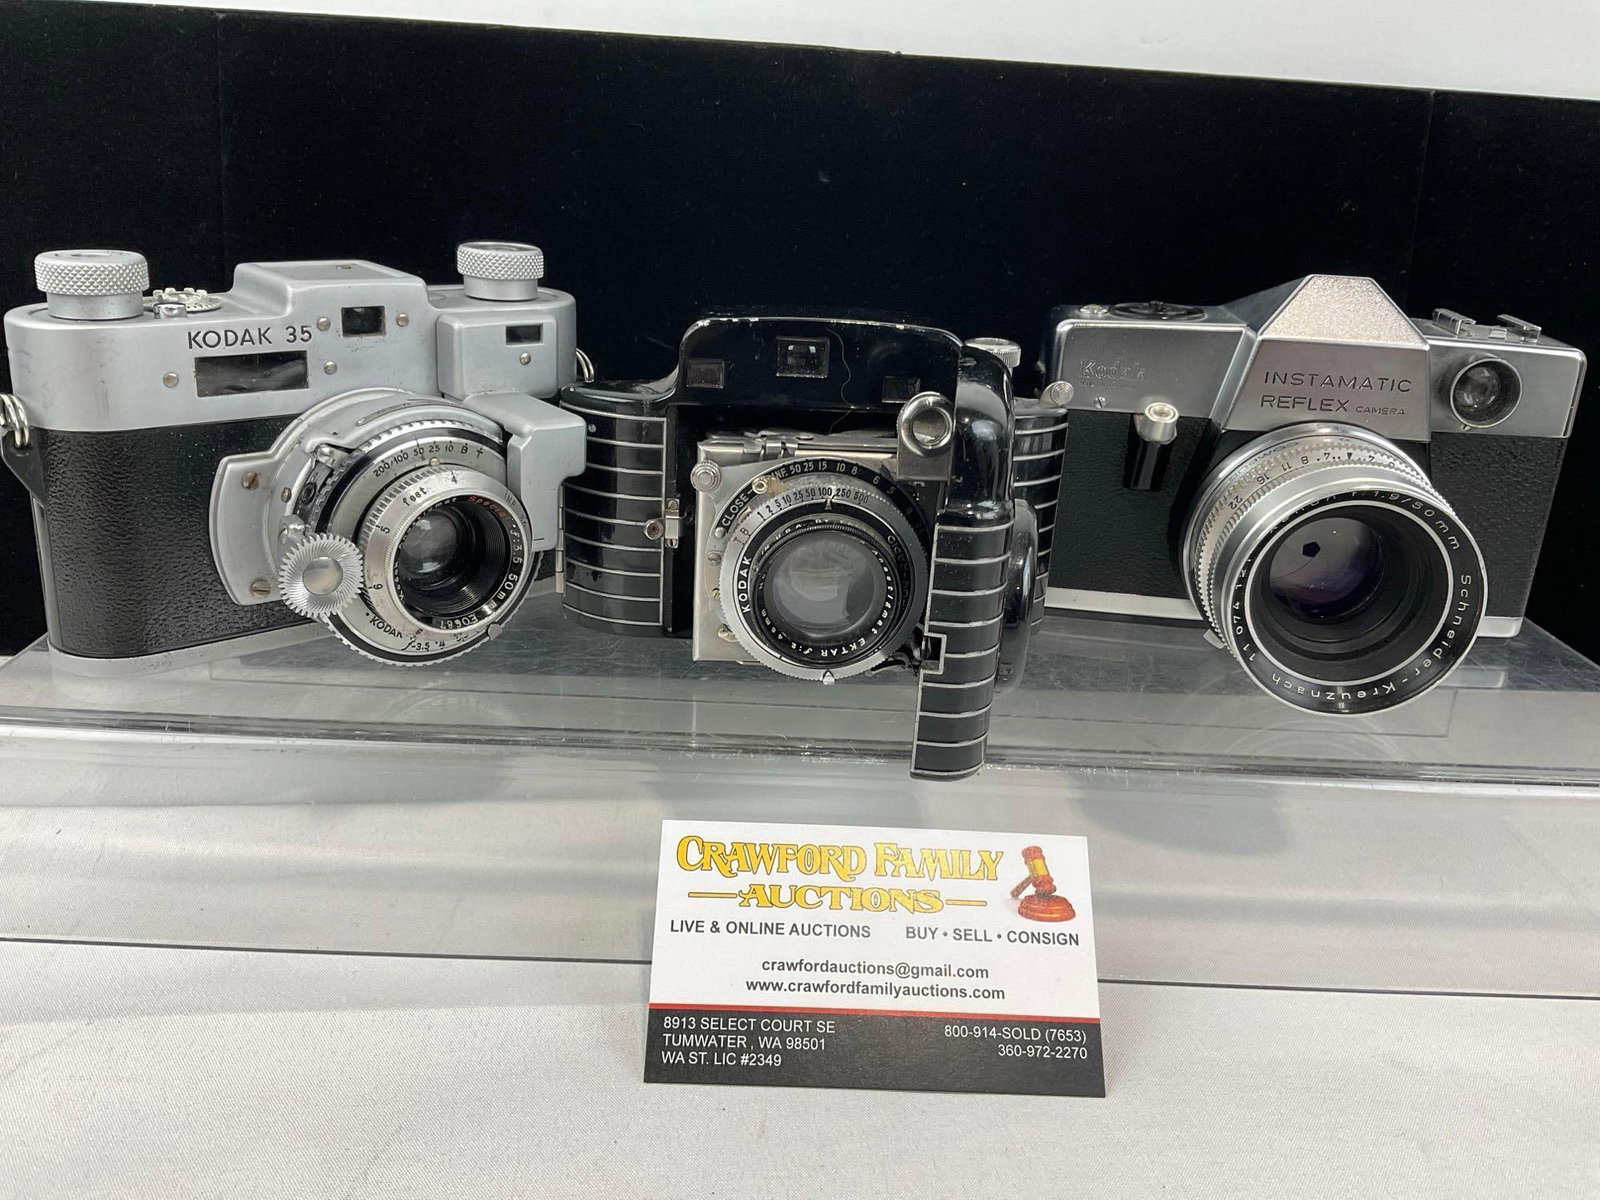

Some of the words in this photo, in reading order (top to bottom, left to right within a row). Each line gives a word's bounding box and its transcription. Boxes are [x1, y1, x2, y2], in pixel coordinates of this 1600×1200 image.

[187, 327, 273, 349] KODAK
[285, 325, 313, 344] 35
[1264, 371, 1412, 393] INSTAMATIC
[1260, 394, 1349, 412] REFLEX
[1355, 405, 1405, 416] CAMERA
[413, 446, 425, 457] 50
[428, 444, 441, 453] 25
[445, 444, 454, 453] 10
[460, 446, 469, 455] B
[1228, 494, 1244, 510] 22
[1256, 474, 1270, 485] 16
[1281, 462, 1292, 472] 11
[1301, 456, 1309, 465] 8
[402, 486, 428, 507] feet
[721, 492, 750, 527] CLOSE
[789, 464, 801, 475] 50
[803, 461, 814, 472] 25
[818, 461, 828, 470] 15
[836, 462, 846, 472] 10
[851, 465, 859, 475] 8
[872, 475, 881, 485] 6
[765, 504, 773, 514] 2
[774, 498, 781, 508] 5
[782, 494, 792, 504] 10
[793, 491, 804, 501] 25
[805, 488, 816, 497] 50
[818, 487, 833, 496] 100
[836, 488, 851, 498] 250
[854, 491, 869, 503] 500
[738, 556, 753, 614] KODAK
[820, 637, 866, 657] EKTAR
[676, 835, 867, 882] CRAWFORD
[874, 842, 1004, 881] FAMILY
[738, 883, 944, 914] AUCTIONS
[670, 919, 705, 933] LIVE
[710, 921, 720, 933] &
[726, 921, 785, 935] ONLINE
[789, 923, 871, 938] AUCTIONS
[905, 926, 938, 940] BUY
[952, 928, 992, 942] SELL
[1006, 930, 1079, 946] CONSIGN
[762, 959, 989, 979] crawfordauctions@gmail.com
[746, 980, 1005, 1000] www.crawfordfamilyauctions.com
[663, 1016, 696, 1029] 8913
[700, 1017, 756, 1031] SELECT
[760, 1019, 812, 1033] COURT
[816, 1020, 835, 1034] SE
[944, 1025, 1041, 1041] 800-914-SOLD
[1045, 1028, 1087, 1044] (7653)
[663, 1033, 747, 1048] TUMWATER
[758, 1036, 782, 1049] WA
[786, 1037, 826, 1050] 98501
[661, 1051, 685, 1064] WA
[688, 1052, 709, 1065] ST.
[714, 1053, 737, 1065] LIC
[740, 1053, 782, 1066] #2349
[998, 1044, 1088, 1060] 360-972-2270
